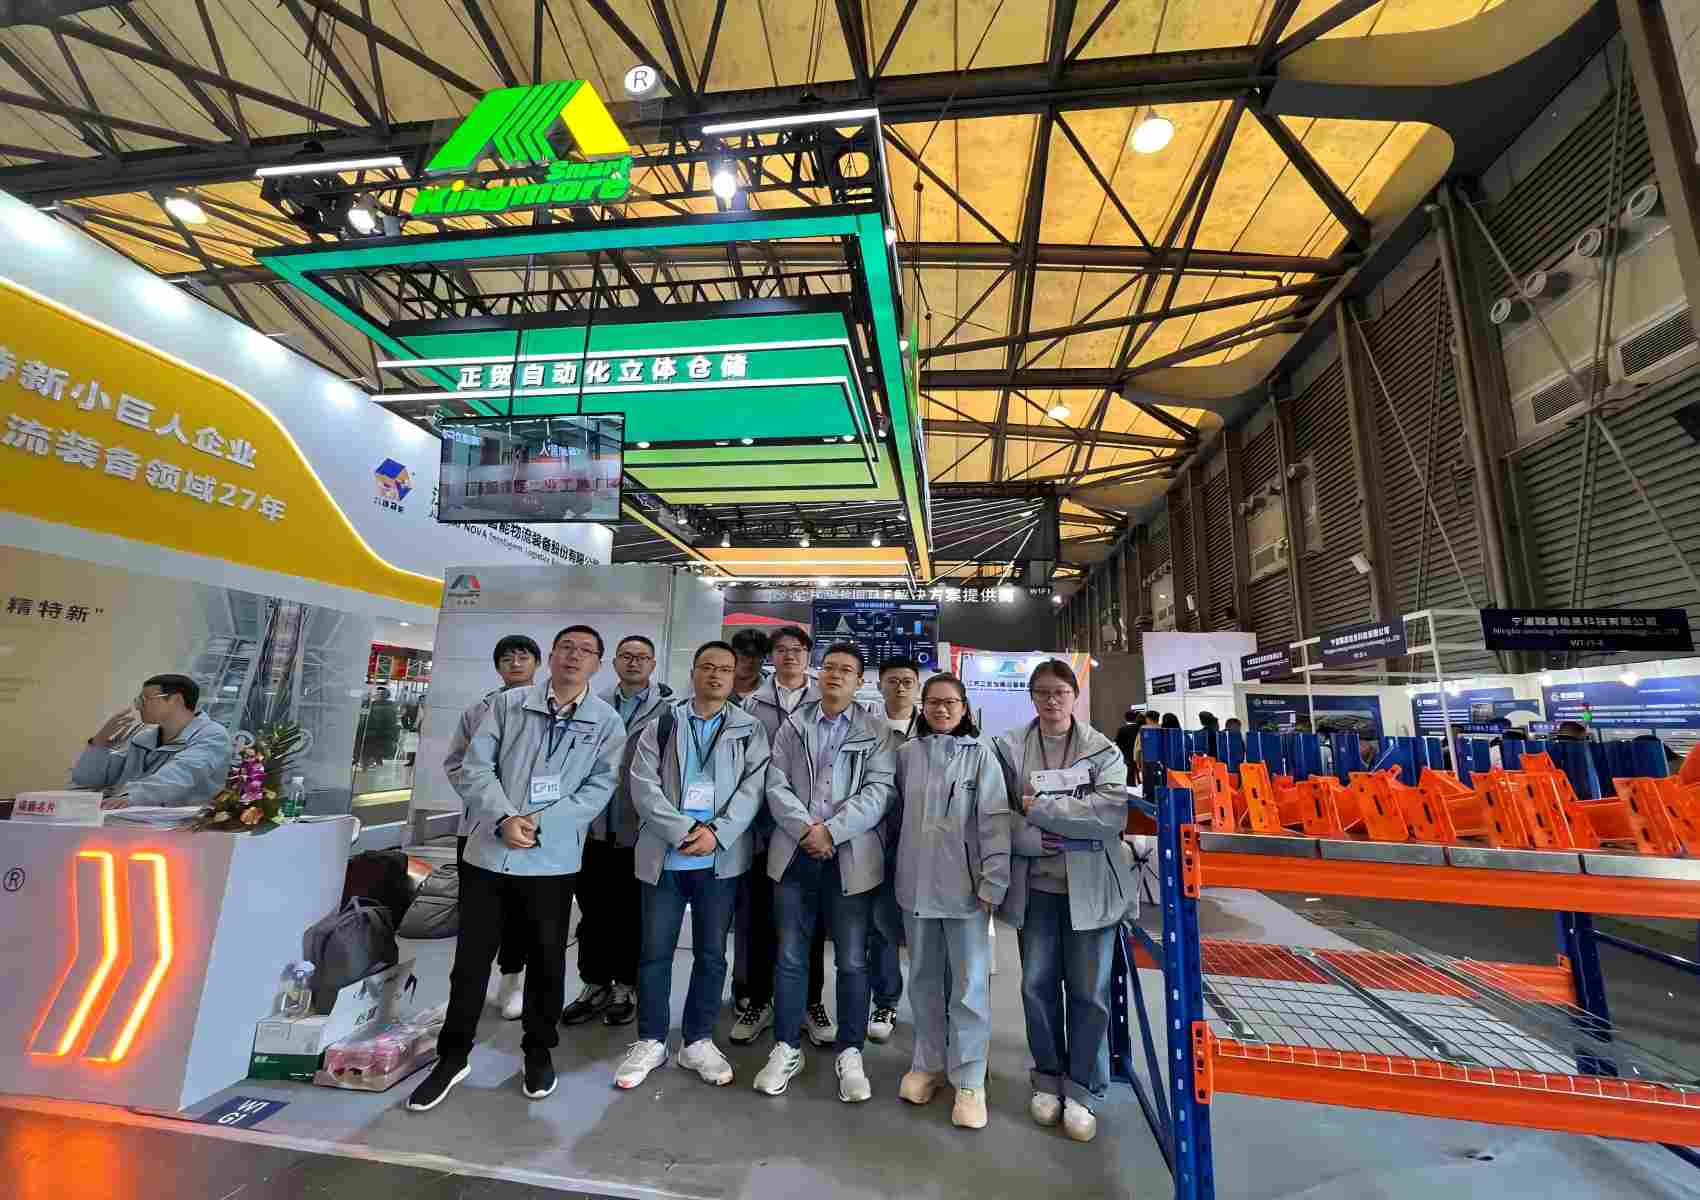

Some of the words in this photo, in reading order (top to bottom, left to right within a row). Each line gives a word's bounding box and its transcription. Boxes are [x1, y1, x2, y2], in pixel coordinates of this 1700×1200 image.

[545, 155, 633, 182] Smart
[411, 178, 632, 216] Kingmore
[457, 353, 748, 390] 正贸自动化立体仓储
